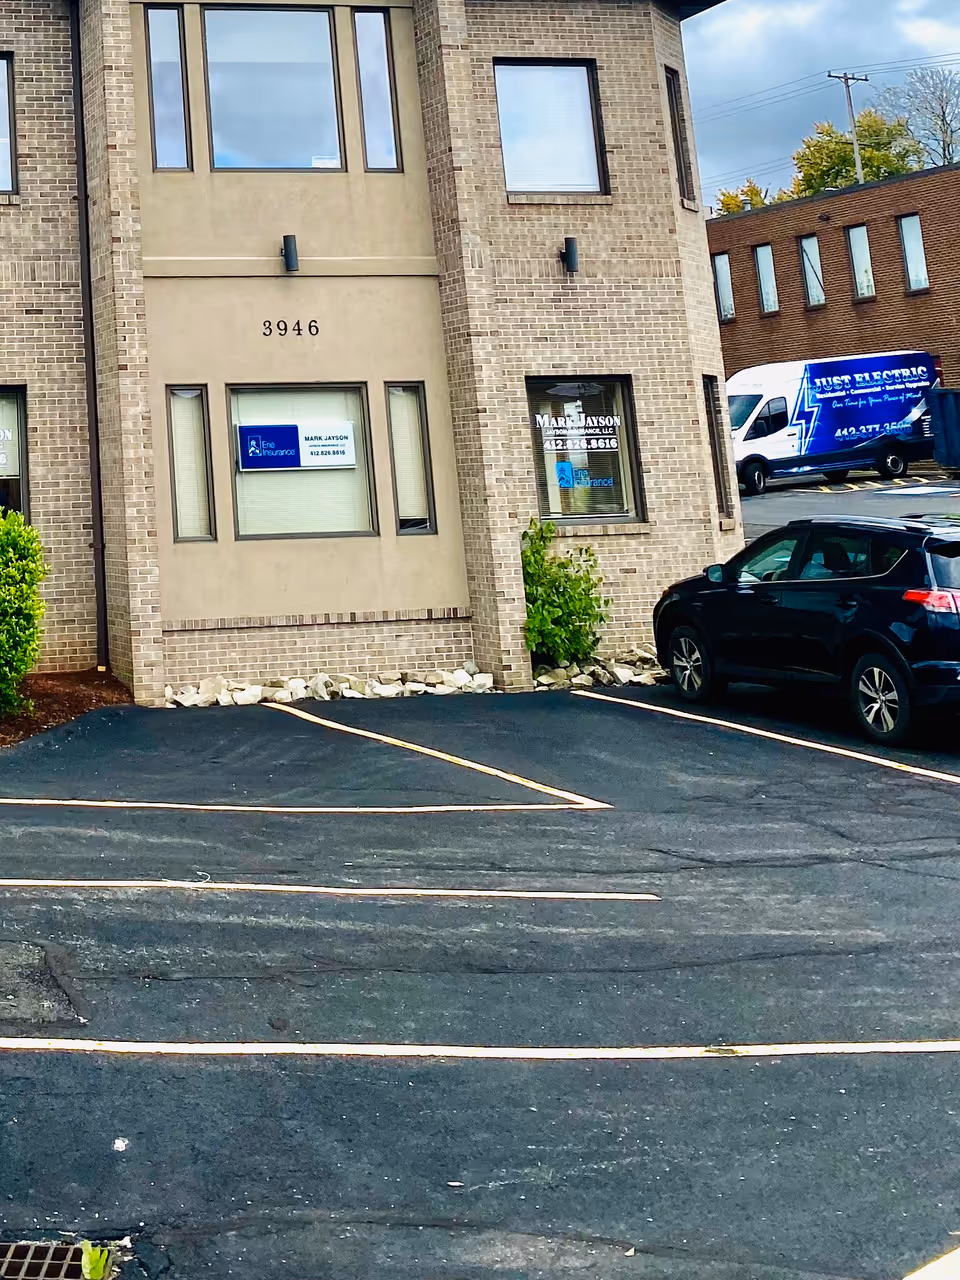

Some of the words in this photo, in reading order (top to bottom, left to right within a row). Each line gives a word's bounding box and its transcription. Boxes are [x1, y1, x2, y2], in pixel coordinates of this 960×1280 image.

[262, 319, 320, 337] 3946
[813, 375, 852, 392] JUST
[853, 366, 929, 387] ELECTRIC
[535, 414, 576, 428] MARK
[577, 413, 620, 427] JAYSON
[261, 440, 276, 449] Erie
[544, 439, 617, 450] 412.826.8616
